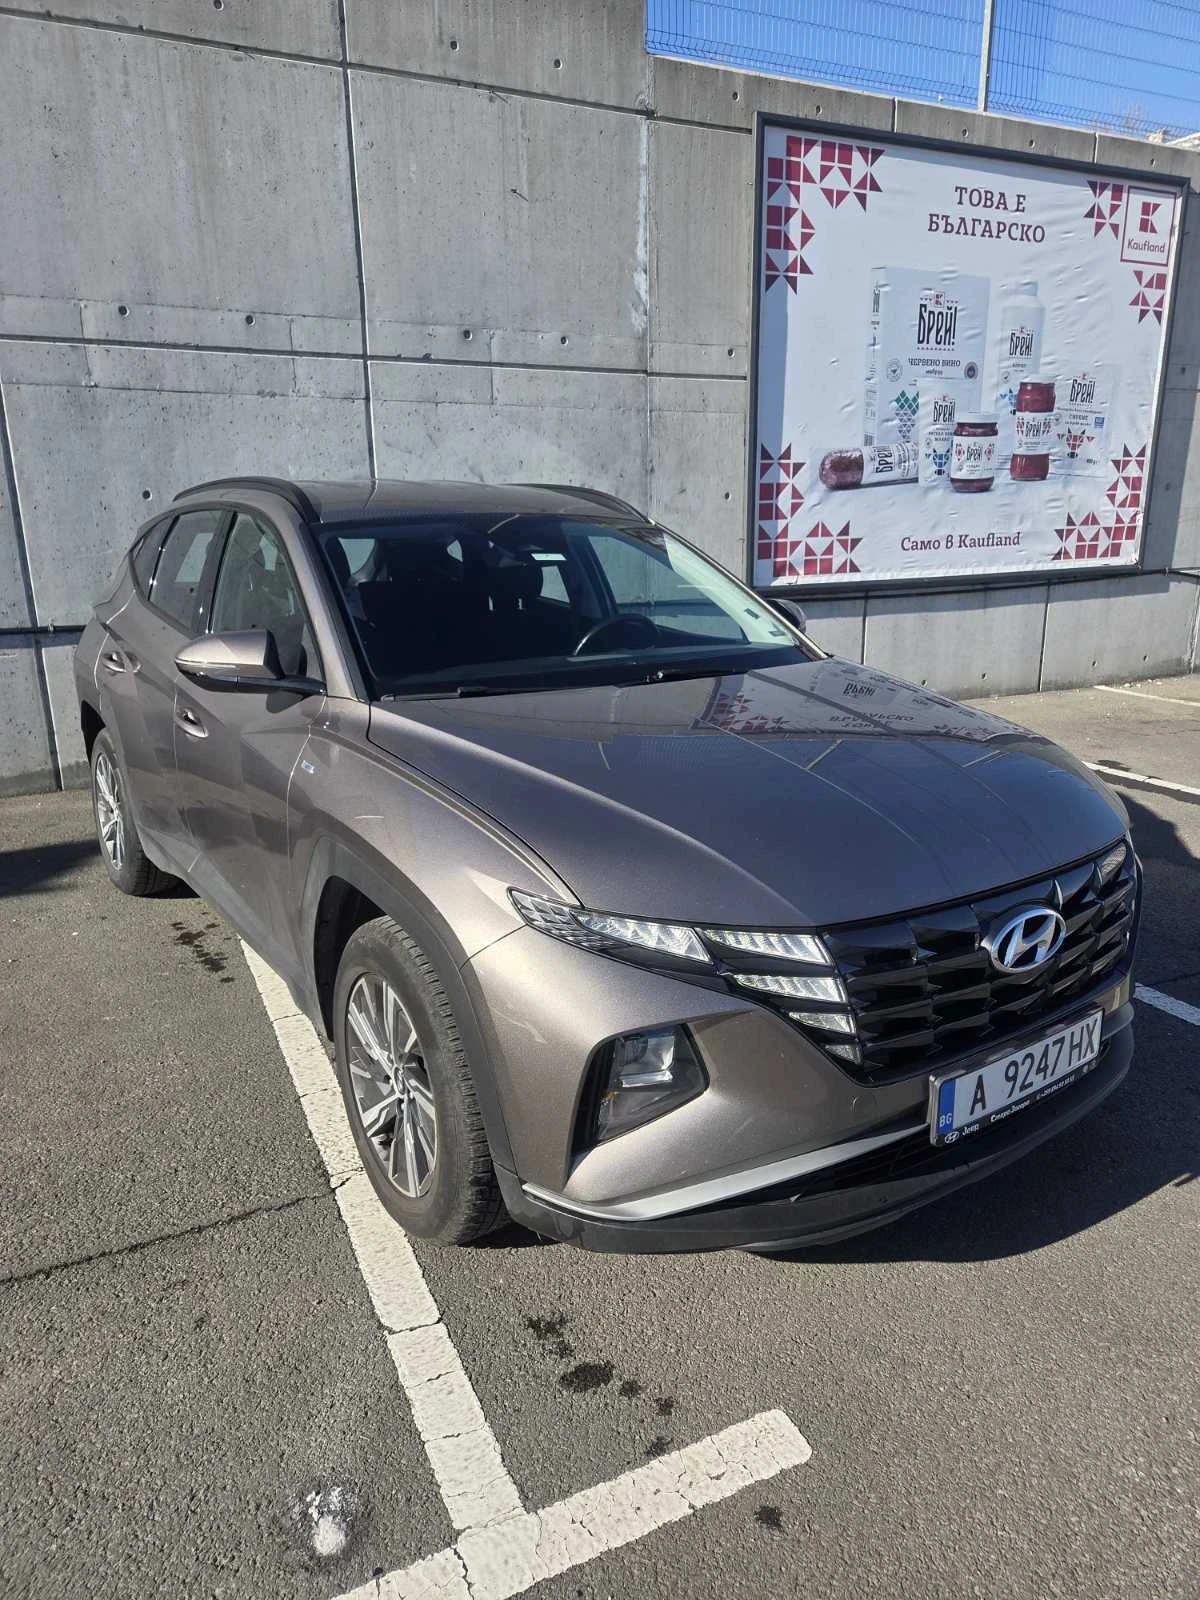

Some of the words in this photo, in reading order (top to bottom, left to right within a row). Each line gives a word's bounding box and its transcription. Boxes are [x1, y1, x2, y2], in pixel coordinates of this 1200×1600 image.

[955, 186, 1009, 211] ТОВА
[1015, 193, 1026, 213] Е
[928, 213, 1046, 243] БЪЛГАРСКО
[1127, 238, 1166, 253] Kaufland
[917, 303, 958, 346] Брей!
[900, 536, 941, 551] Само
[945, 534, 954, 549] в
[958, 531, 1021, 548] Kaufland
[969, 1074, 987, 1116] A
[1004, 1035, 1066, 1099] 9247
[1068, 1018, 1098, 1067] HX
[939, 1112, 953, 1128] BG
[962, 1123, 980, 1136] Jeep
